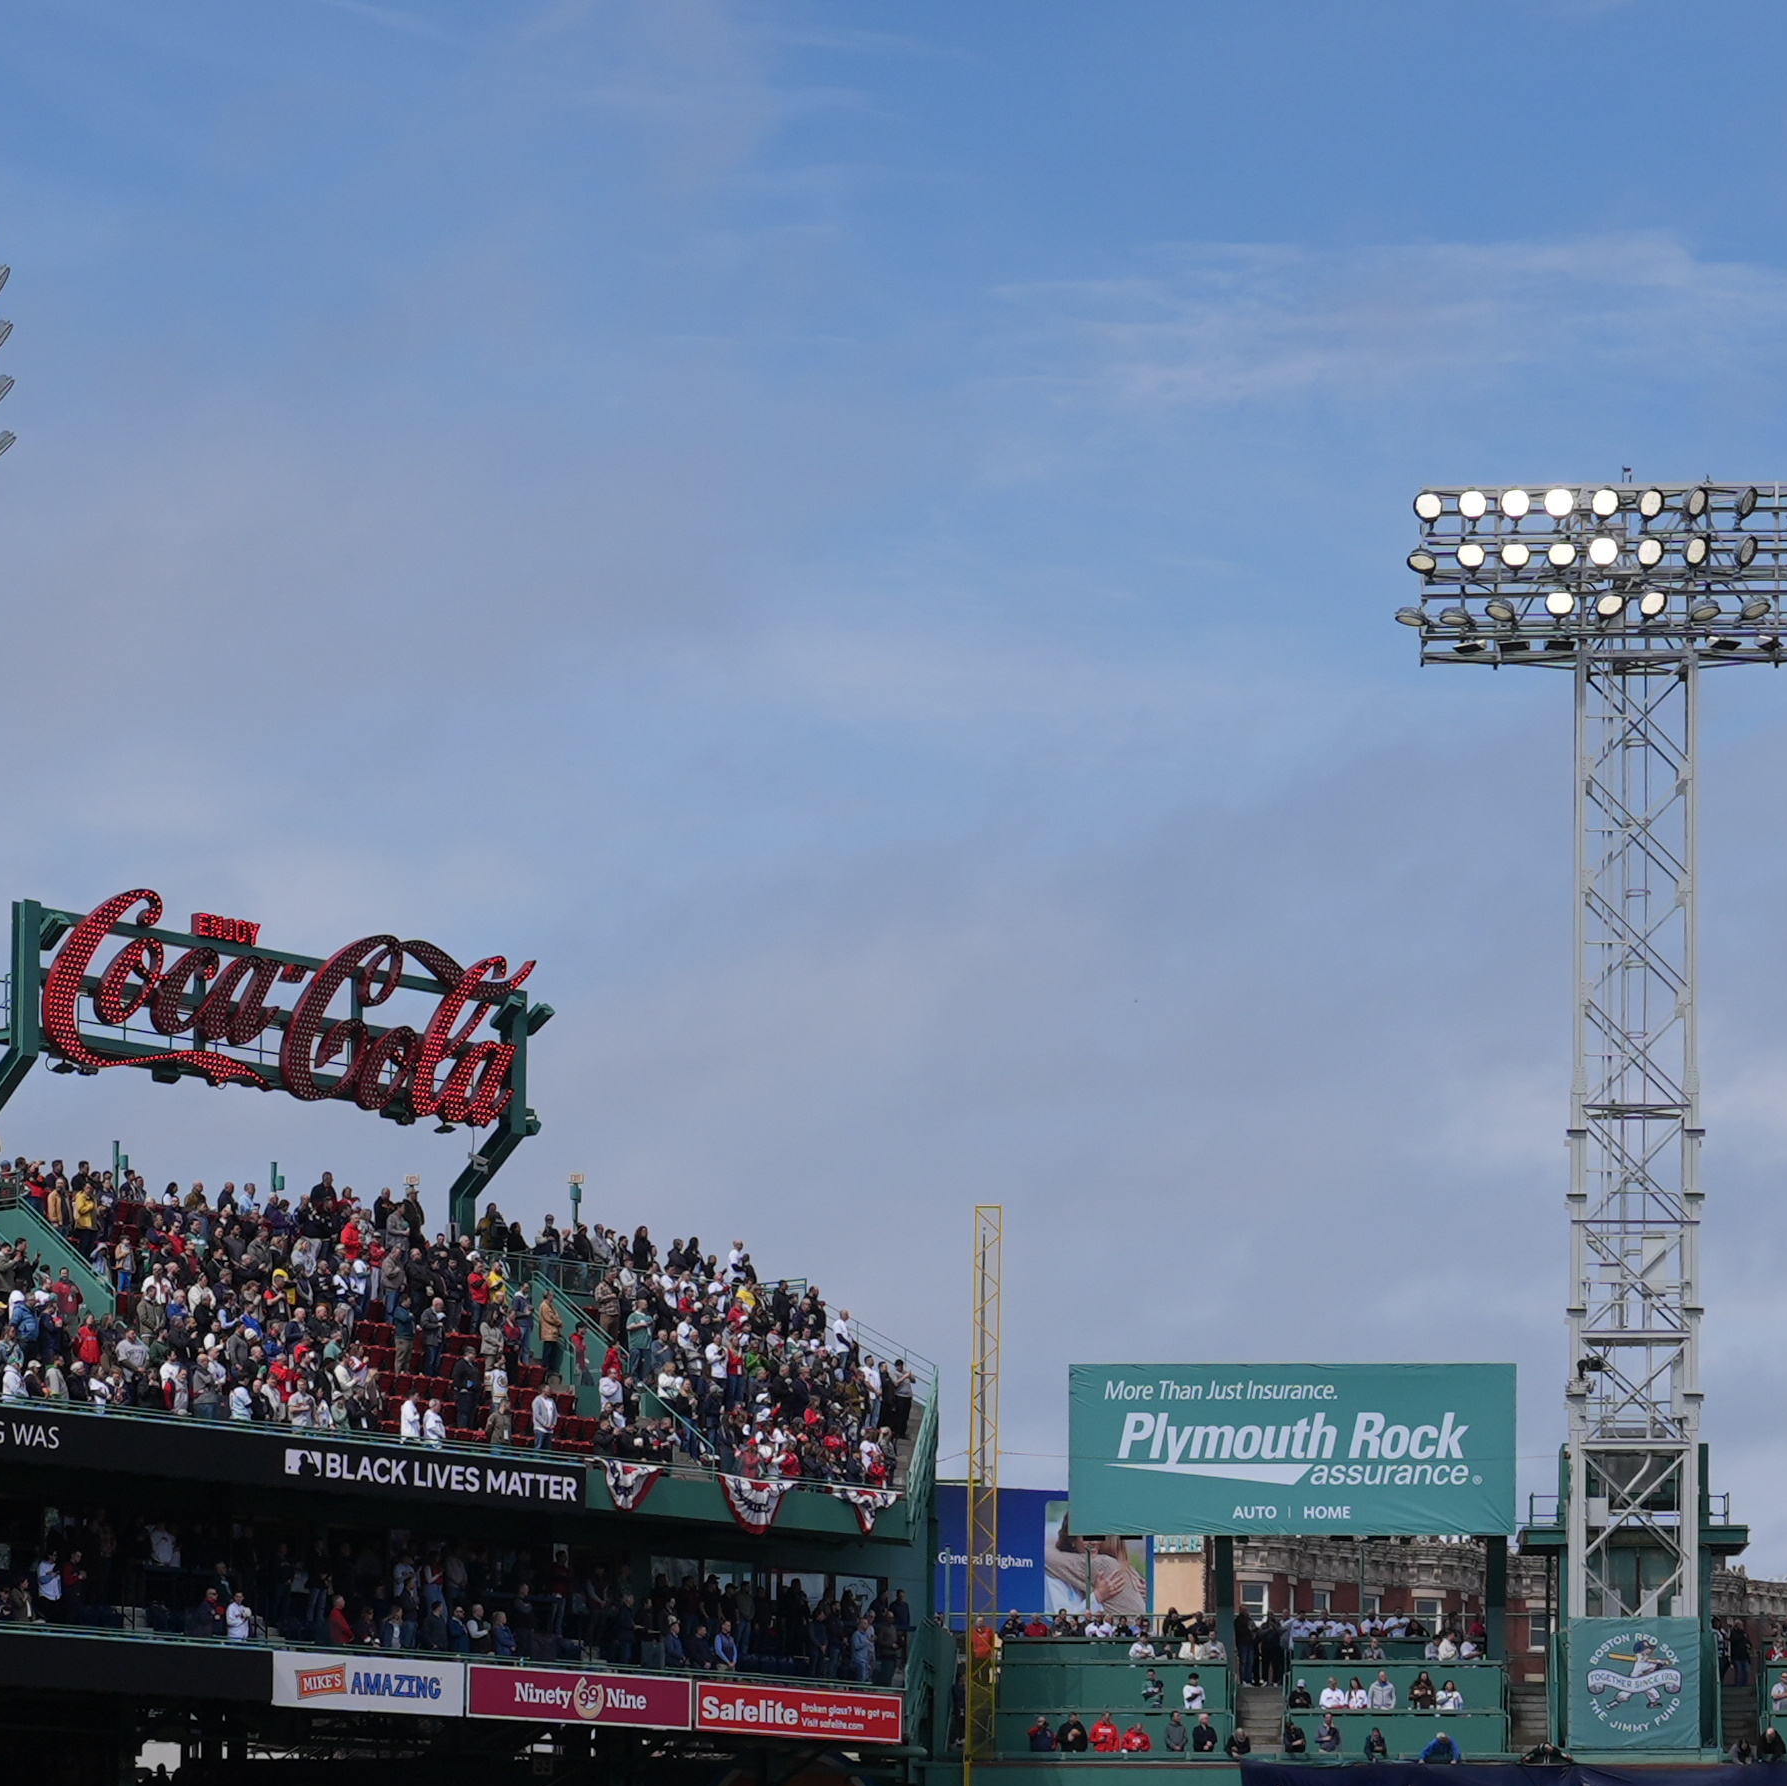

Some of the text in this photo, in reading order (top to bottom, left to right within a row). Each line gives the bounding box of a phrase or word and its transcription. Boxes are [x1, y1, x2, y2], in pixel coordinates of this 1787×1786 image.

[195, 912, 261, 947] ENJOY
[41, 887, 537, 1128] Coca-Cola
[1104, 1380, 1338, 1401] More Than Just Insurance.
[12, 1422, 60, 1450] WAS
[1117, 1411, 1470, 1465] Plymouth Rock
[325, 1452, 577, 1502] BLACK LIVES MATTER
[1310, 1464, 1469, 1486] assurance
[1232, 1506, 1351, 1519] AUTO HOME
[985, 1553, 1034, 1570] Brigham
[1589, 1632, 1680, 1666] BOSTON RED SOX
[301, 1671, 442, 1699] MIKE'S AMAZING
[1590, 1673, 1633, 1689] TOGETHER
[1634, 1674, 1659, 1689] SINCE
[514, 1681, 573, 1709] Ninety
[606, 1688, 647, 1710] Nine
[701, 1696, 799, 1725] Safelite
[801, 1702, 827, 1715] Broken
[828, 1704, 852, 1717] glass?
[853, 1706, 866, 1716] We
[867, 1708, 880, 1720] got
[801, 1717, 865, 1731] Visit safelite.com
[1589, 1697, 1681, 1732] THE JIMMY FUND
